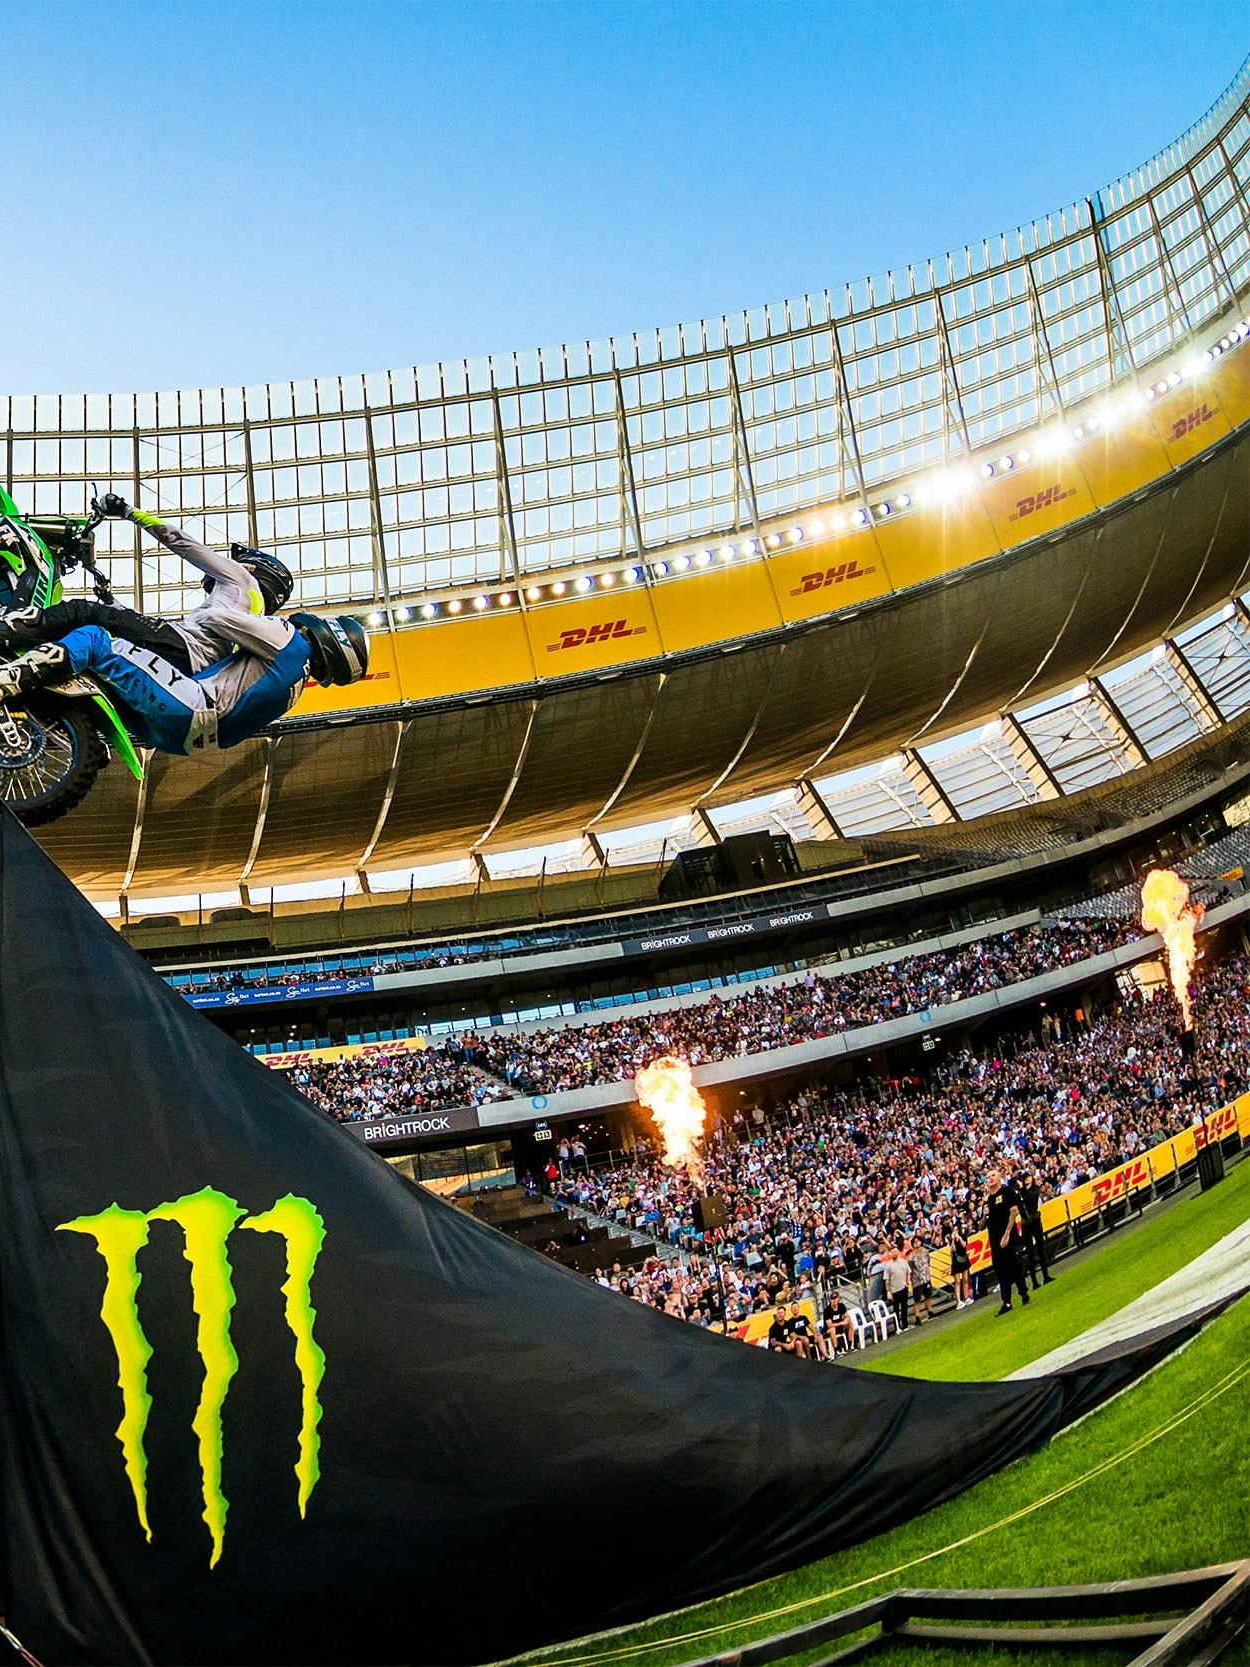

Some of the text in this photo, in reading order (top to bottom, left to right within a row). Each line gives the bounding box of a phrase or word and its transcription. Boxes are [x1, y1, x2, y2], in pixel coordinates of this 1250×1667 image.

[1172, 403, 1214, 441] DHL
[1016, 485, 1068, 517] DHL
[801, 562, 863, 593] DHL
[559, 620, 634, 648] DHL
[265, 1053, 312, 1067] DHL
[362, 1042, 409, 1058] DHL
[1193, 1108, 1236, 1148] DHL
[1092, 1161, 1148, 1207] DHL
